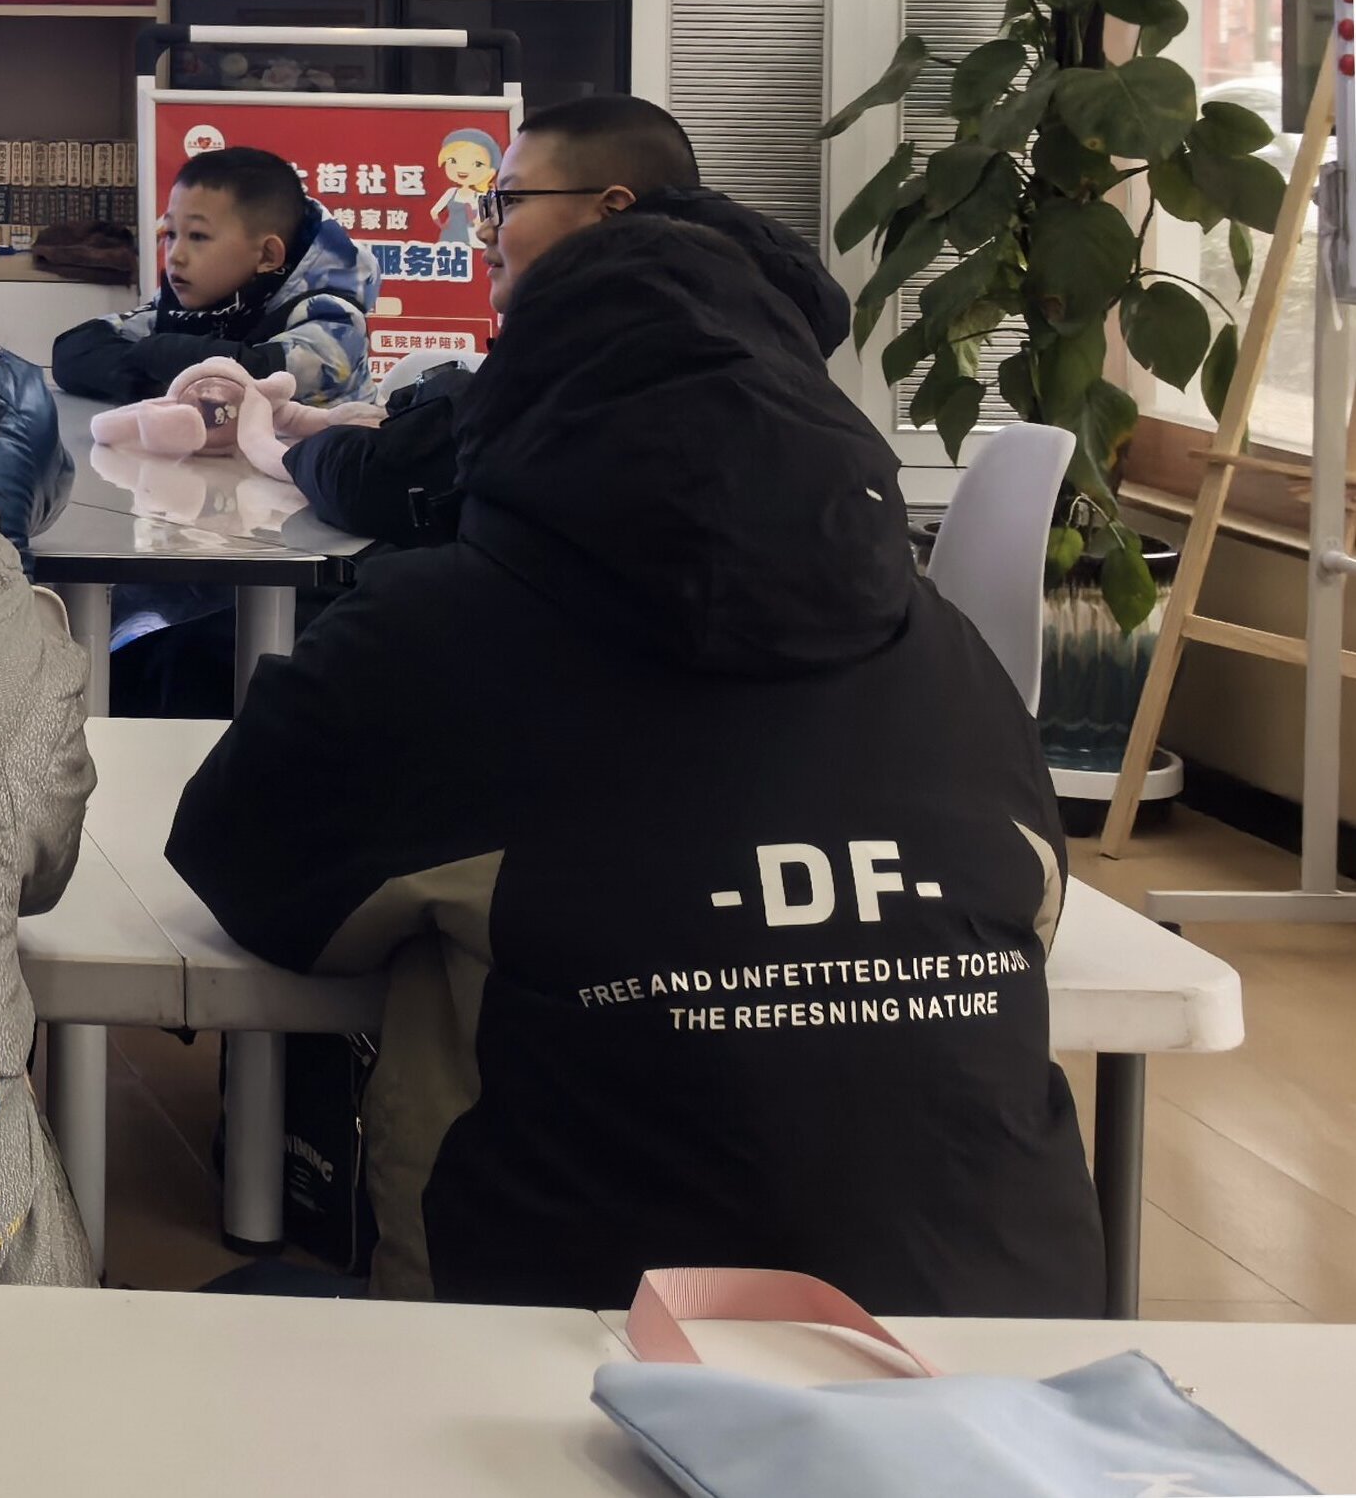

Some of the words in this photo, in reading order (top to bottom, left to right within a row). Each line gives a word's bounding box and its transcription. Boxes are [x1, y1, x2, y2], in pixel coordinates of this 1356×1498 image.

[372, 244, 469, 278] 服务站
[380, 335, 467, 350] 医院陪护陪诊
[578, 977, 645, 1008] FREE
[650, 969, 713, 996] AND
[720, 958, 891, 992] UNFETTTED
[895, 955, 951, 981] LIFE
[669, 1006, 726, 1032] THE
[734, 995, 900, 1030] REFESNING
[908, 991, 999, 1021] NATURE
